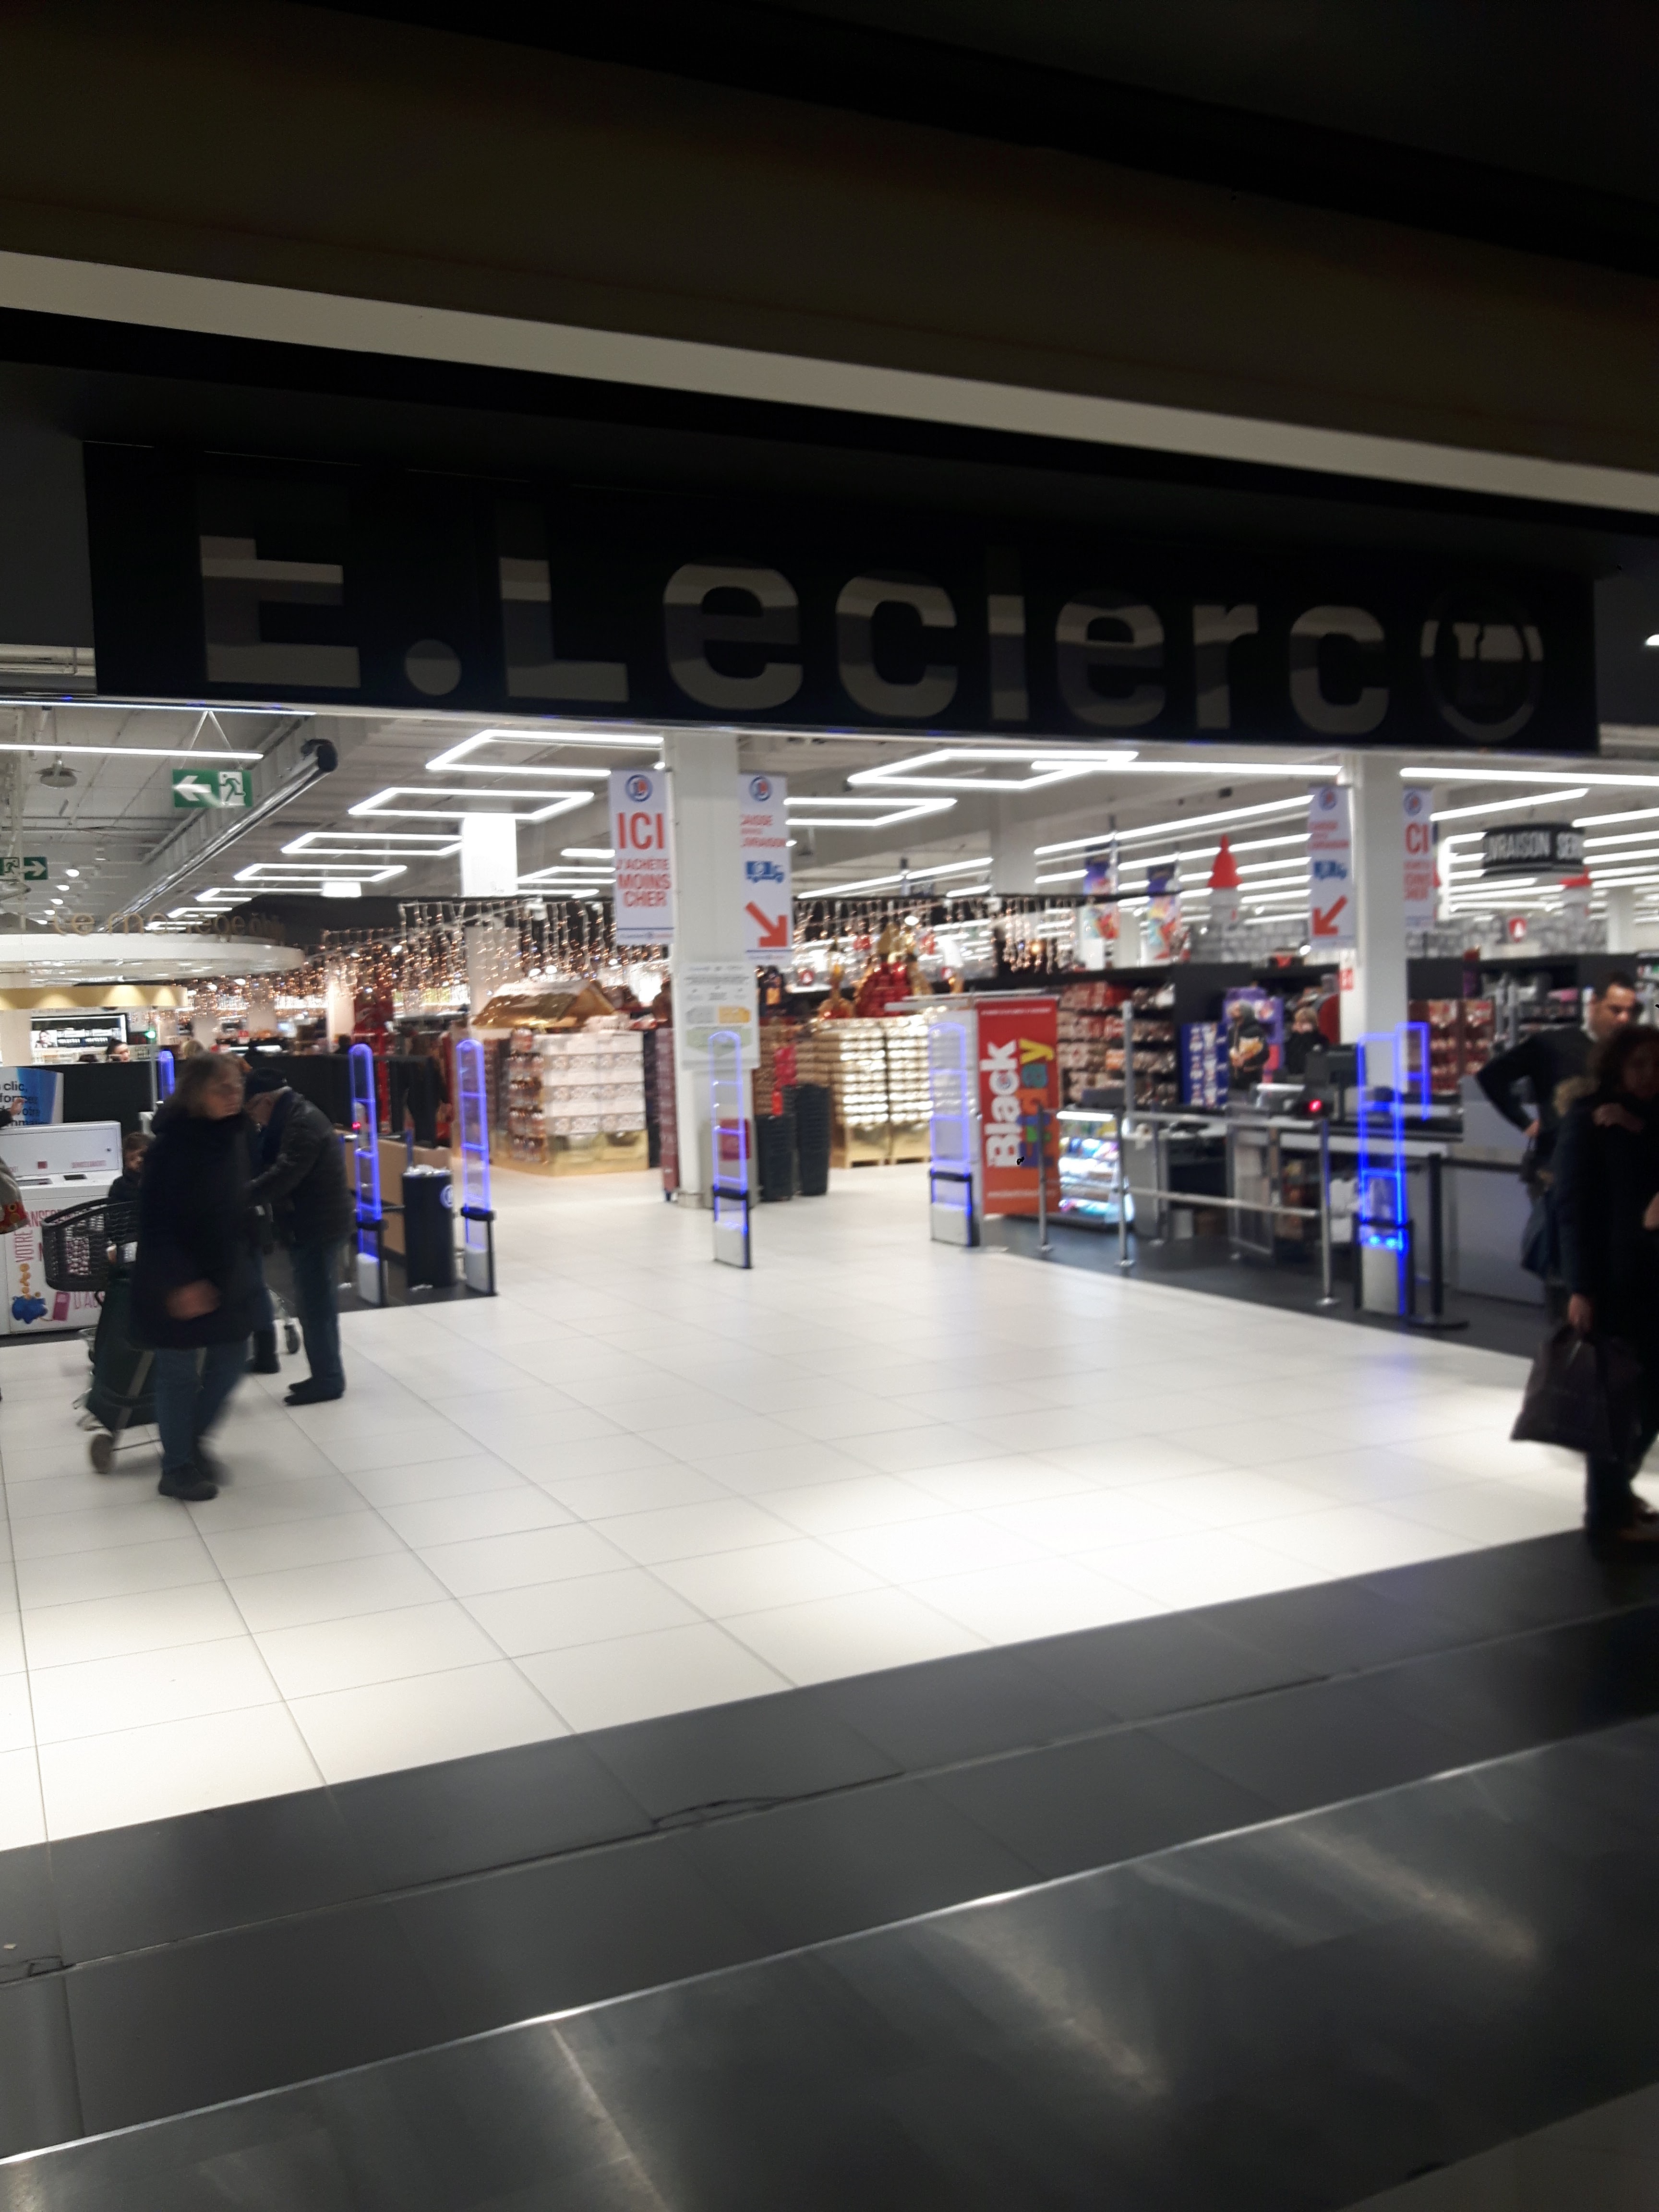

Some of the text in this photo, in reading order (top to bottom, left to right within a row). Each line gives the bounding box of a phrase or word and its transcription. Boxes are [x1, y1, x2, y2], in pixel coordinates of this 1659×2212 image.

[197, 482, 1389, 735] E.Leclerc
[616, 812, 664, 850] ICI
[1406, 822, 1430, 854] CI
[617, 873, 671, 890] MOINS
[624, 891, 667, 907] CHER
[4, 1081, 28, 1093] clic,
[979, 1039, 1022, 1167] Black
[14, 1230, 34, 1262] VOTRE
